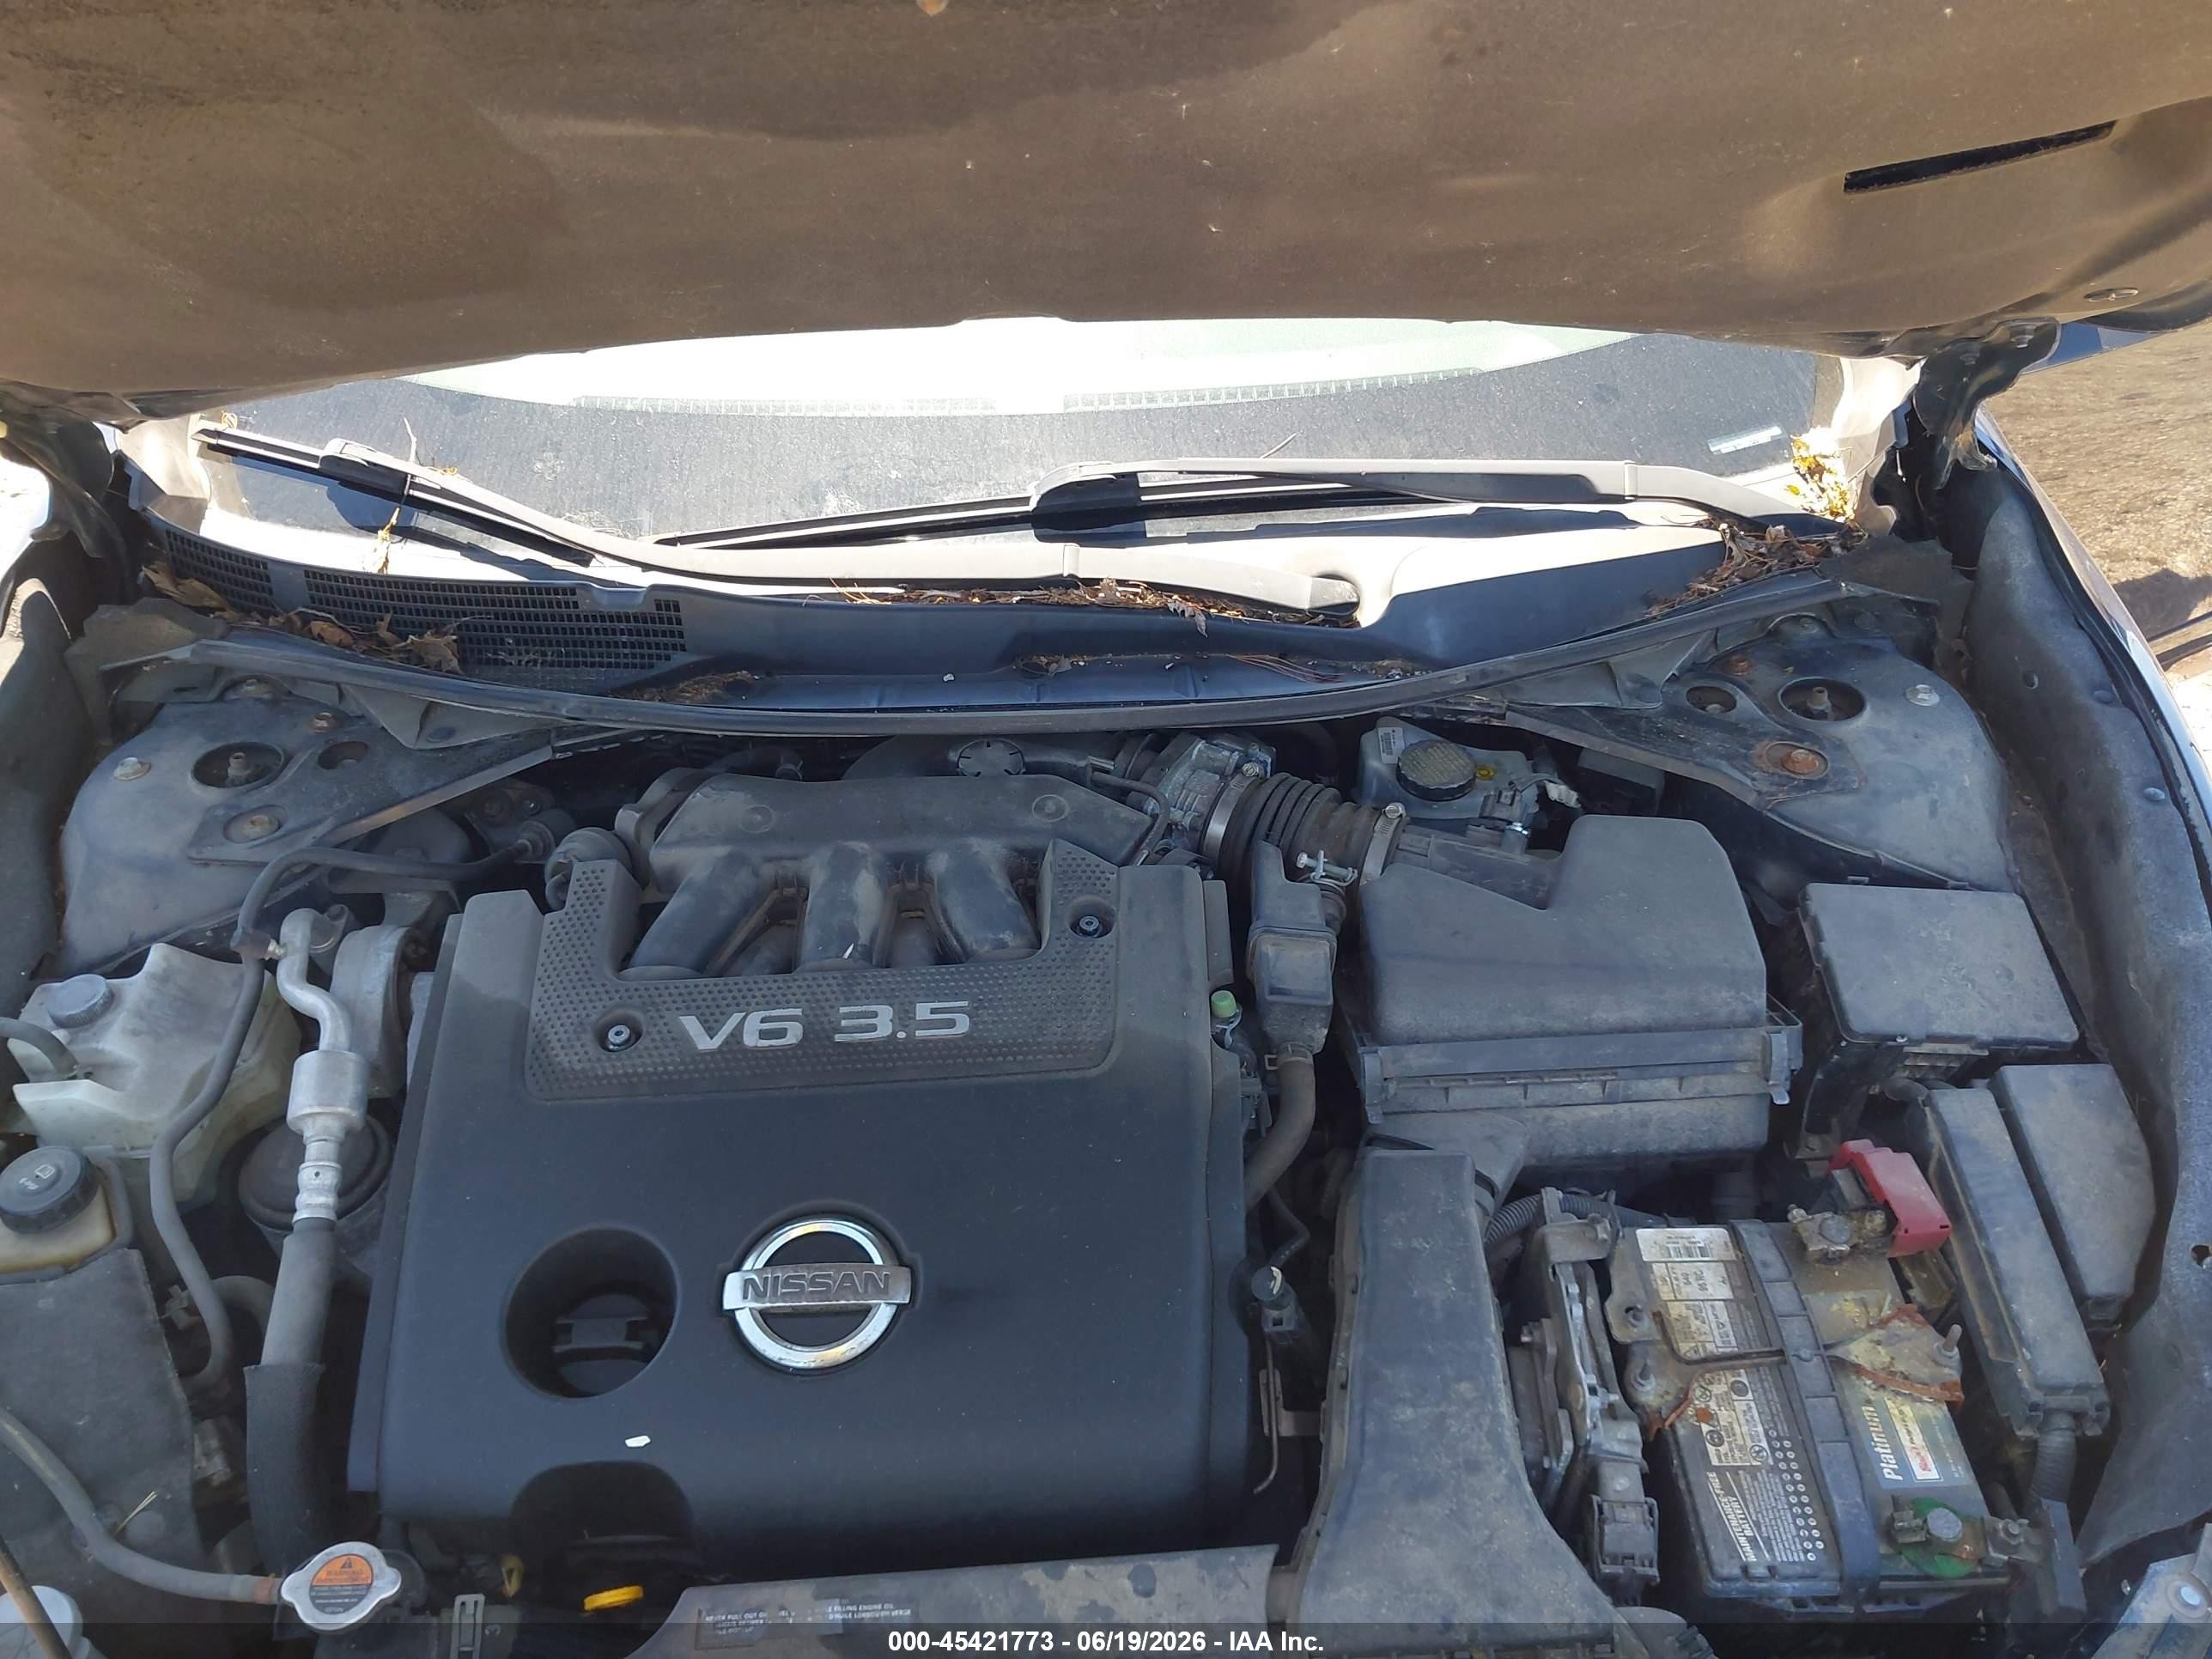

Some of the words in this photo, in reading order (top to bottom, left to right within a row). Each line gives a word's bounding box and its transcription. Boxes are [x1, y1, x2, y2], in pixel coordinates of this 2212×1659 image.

[678, 1007, 804, 1051] V6
[834, 1000, 970, 1042] 3.5
[741, 1271, 892, 1301] NISSAN
[1861, 1406, 1904, 1480] Platinum
[1706, 1471, 1758, 1562] MAINTENANCE-FREE
[1727, 1496, 1754, 1536] BATTERY
